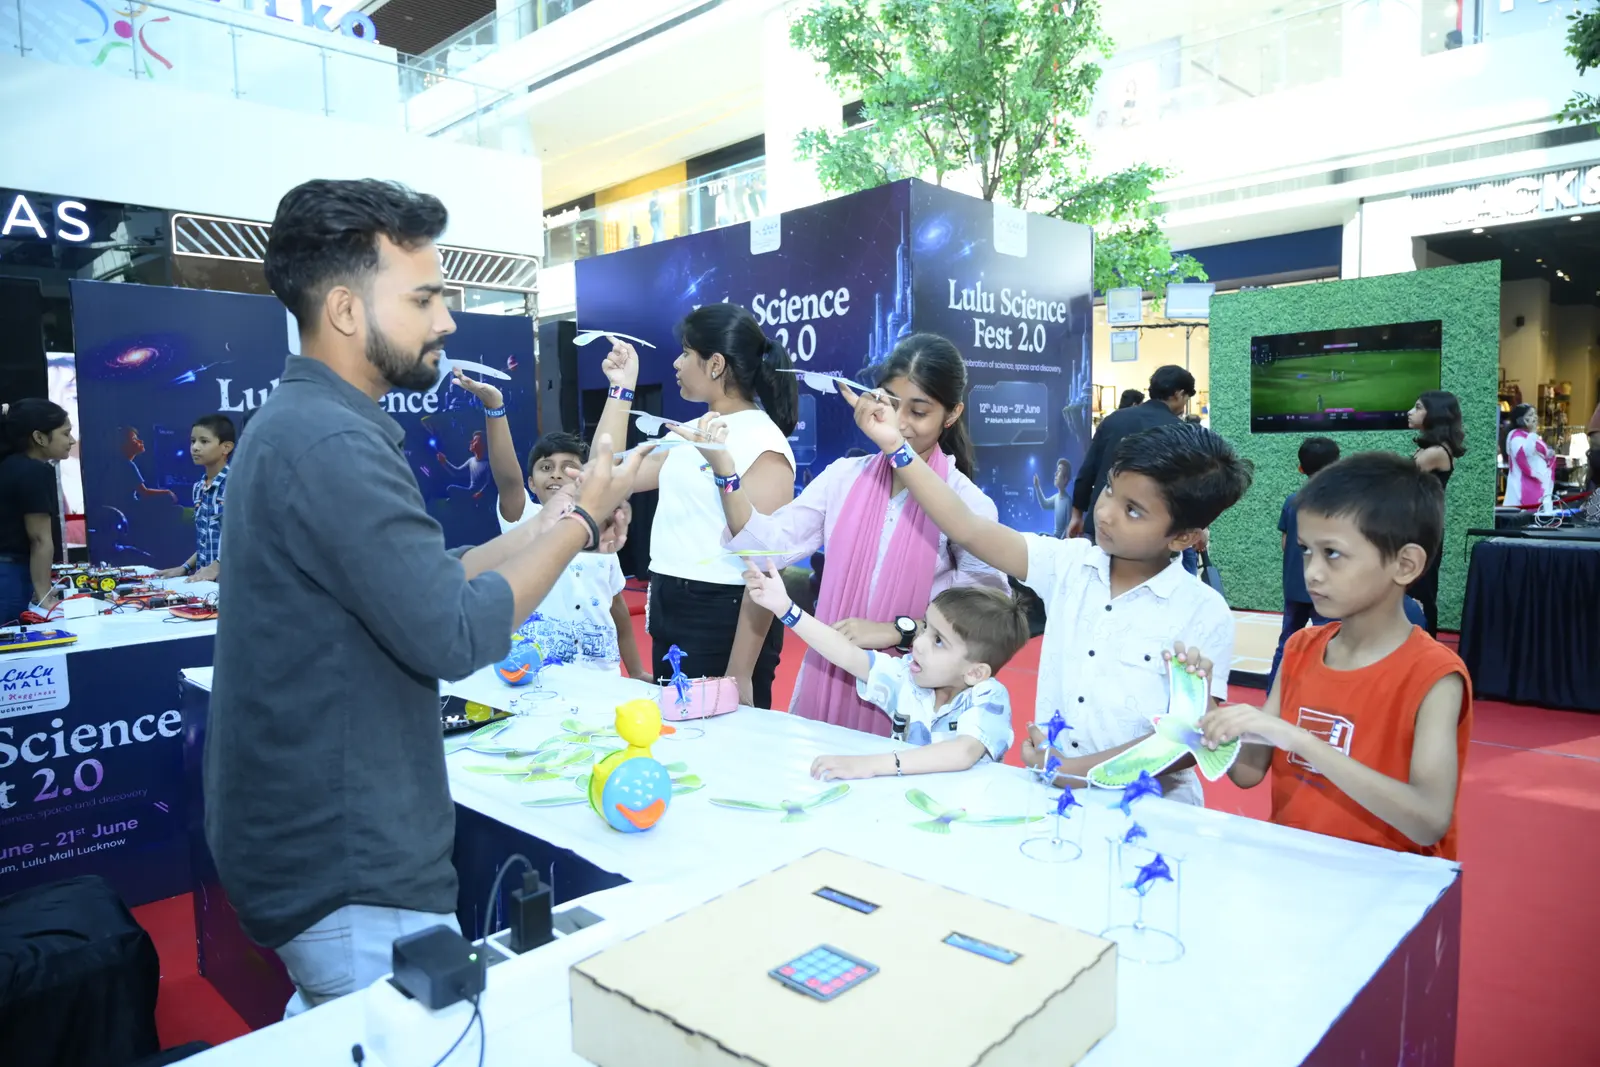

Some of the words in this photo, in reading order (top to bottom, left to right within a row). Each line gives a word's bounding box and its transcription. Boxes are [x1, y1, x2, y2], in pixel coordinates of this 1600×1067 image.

[1, 194, 90, 242] AS
[751, 286, 850, 326] Science
[948, 278, 996, 315] Lulu
[1000, 287, 1067, 324] Science
[973, 317, 1013, 350] Fest
[1017, 321, 1046, 353] 2.0
[991, 403, 1008, 414] June
[1024, 404, 1041, 414] June
[3, 678, 55, 691] MALL
[32, 758, 104, 802] 2.0
[37, 804, 72, 820] space
[74, 799, 97, 810] and
[98, 788, 148, 805] discovery
[56, 827, 86, 847] 21st
[92, 819, 139, 838] June
[22, 857, 47, 869] Lulu
[50, 849, 74, 862] Mall
[77, 837, 126, 856] Lucknow
